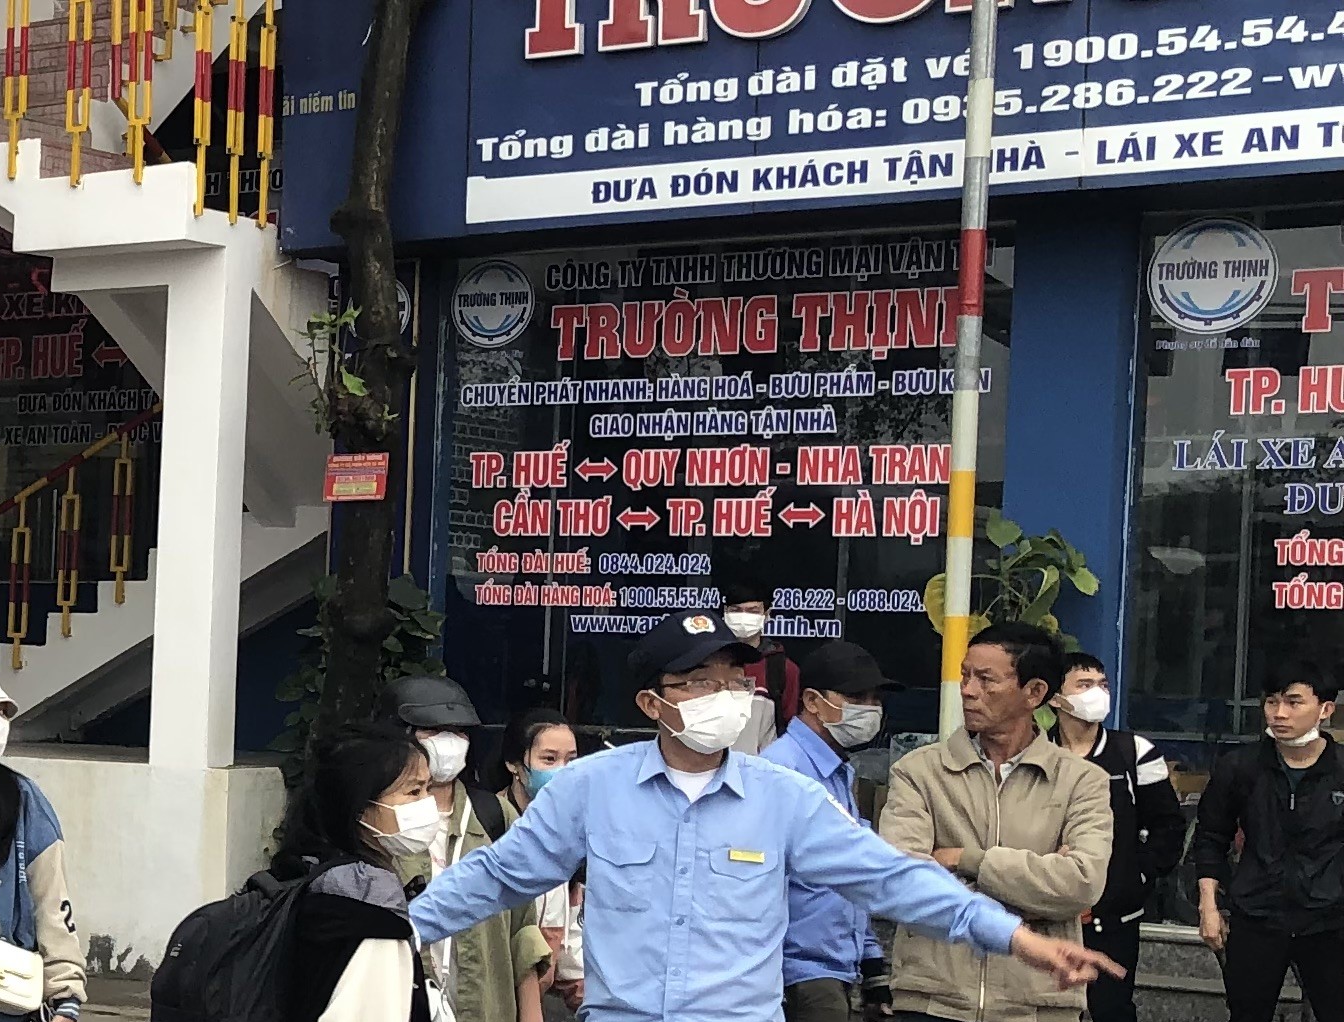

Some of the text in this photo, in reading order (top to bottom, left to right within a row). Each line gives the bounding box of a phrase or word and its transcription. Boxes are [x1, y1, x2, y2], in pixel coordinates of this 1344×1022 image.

[634, 56, 908, 107] Tổng đài đặt
[476, 103, 888, 163] Tổng đài hàng hóa:
[591, 123, 1301, 205] ĐƯA ĐÓN KHÁCH TẬN LÁI XE AN
[544, 248, 825, 292] CÔNG TY TNHH THƯƠNG
[1157, 257, 1270, 283] TRƯỜNG THỊNH
[550, 286, 779, 362] TRƯỜNG
[30, 318, 89, 380] HUẾ
[17, 392, 48, 415] ĐƯA
[51, 387, 83, 412] ĐÓN
[86, 385, 138, 411] KHÁCH
[460, 371, 812, 407] CHUYỂN PHÁT HÀNG BƯU
[1225, 366, 1286, 416] TP.
[26, 420, 92, 446] AN TOÀN
[588, 404, 838, 440] GIAO NHẬN HÀNG TẬN NHÀ
[469, 439, 863, 491] TP. HUẾ QUY NHƠN NHA
[1171, 429, 1317, 471] LÁI XE
[492, 486, 941, 546] CẦN THƠ TP. HUẾ HÀ NỘI
[475, 545, 712, 576] TỔNG 0844.024.024
[1273, 528, 1344, 567] TỔNG
[474, 577, 721, 609] TỔNG 1900.55.55.44
[1271, 572, 1343, 610] TỔNG
[59, 899, 77, 933] 2
